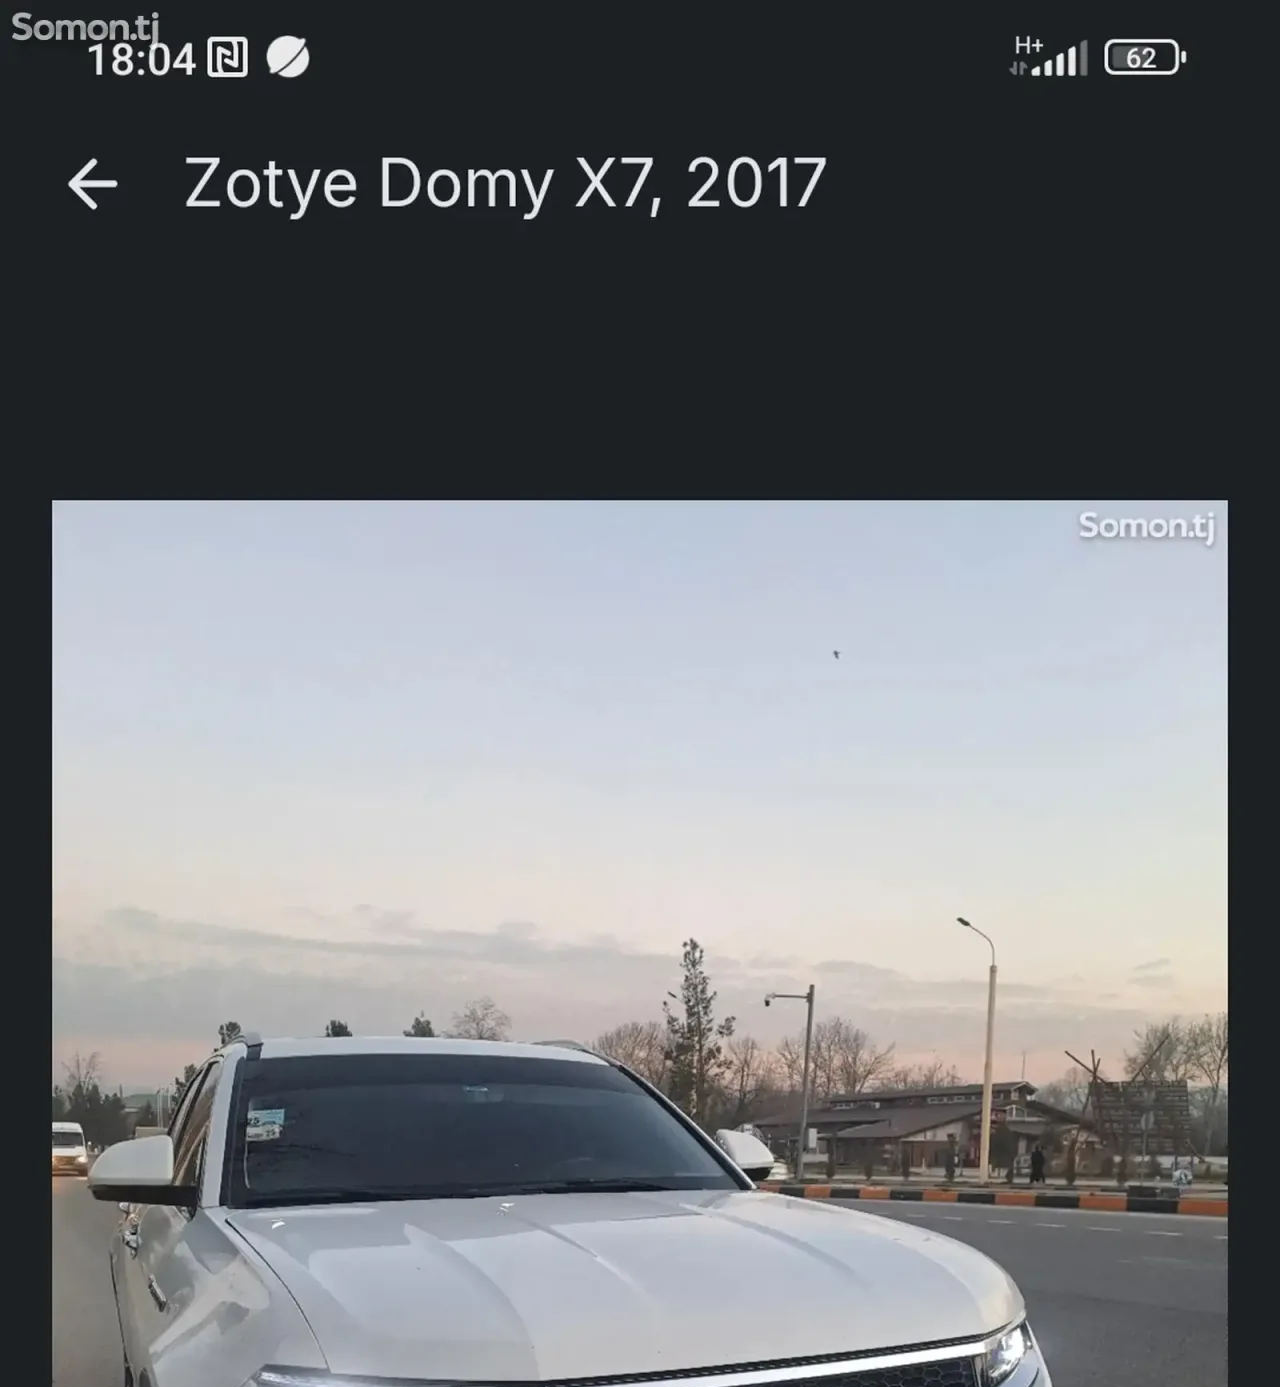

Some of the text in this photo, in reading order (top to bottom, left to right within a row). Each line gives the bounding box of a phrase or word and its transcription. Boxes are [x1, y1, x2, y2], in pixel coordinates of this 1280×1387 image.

[1015, 36, 1043, 54] H+
[1127, 47, 1157, 68] 62
[88, 43, 196, 76] 18:04
[185, 155, 827, 220] Zotye Domy X7, 2017
